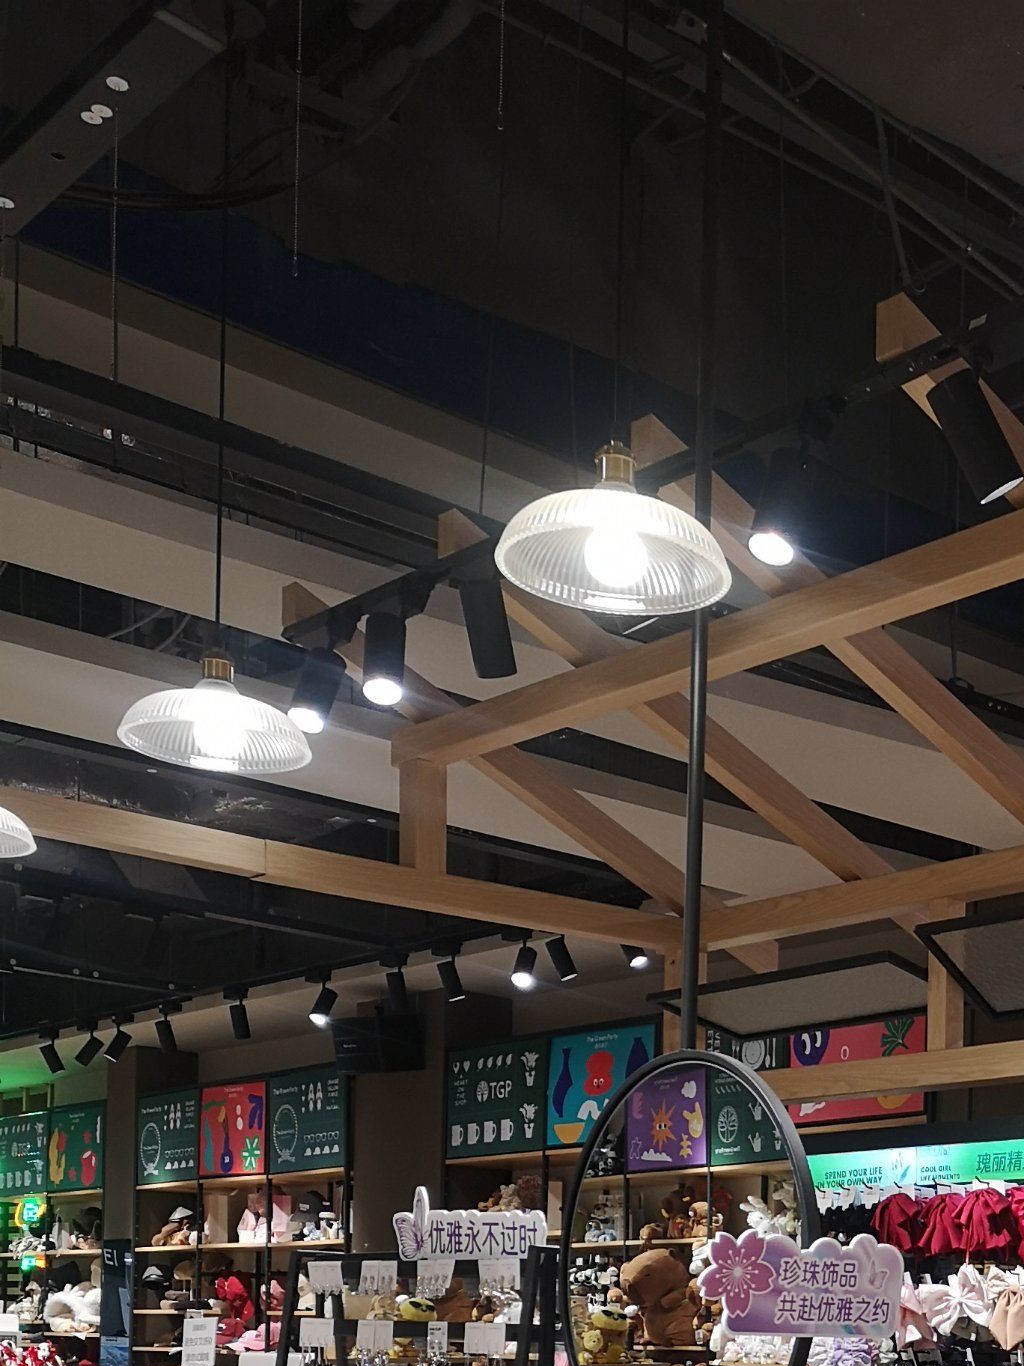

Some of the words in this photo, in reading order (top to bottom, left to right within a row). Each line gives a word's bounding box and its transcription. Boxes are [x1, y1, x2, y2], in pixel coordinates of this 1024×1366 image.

[491, 1080, 513, 1099] TGP
[824, 1171, 847, 1180] SPEND
[848, 1168, 867, 1177] YOUR
[869, 1166, 883, 1176] LIFE
[920, 1165, 937, 1173] COOL
[826, 1179, 847, 1188] YOUR
[847, 1177, 865, 1187] OWN
[866, 1175, 883, 1185] WAY
[430, 1220, 538, 1256] 优雅永不过时
[781, 1260, 858, 1288] 珍珠饰品
[776, 1293, 890, 1324] 共赴优雅之约
